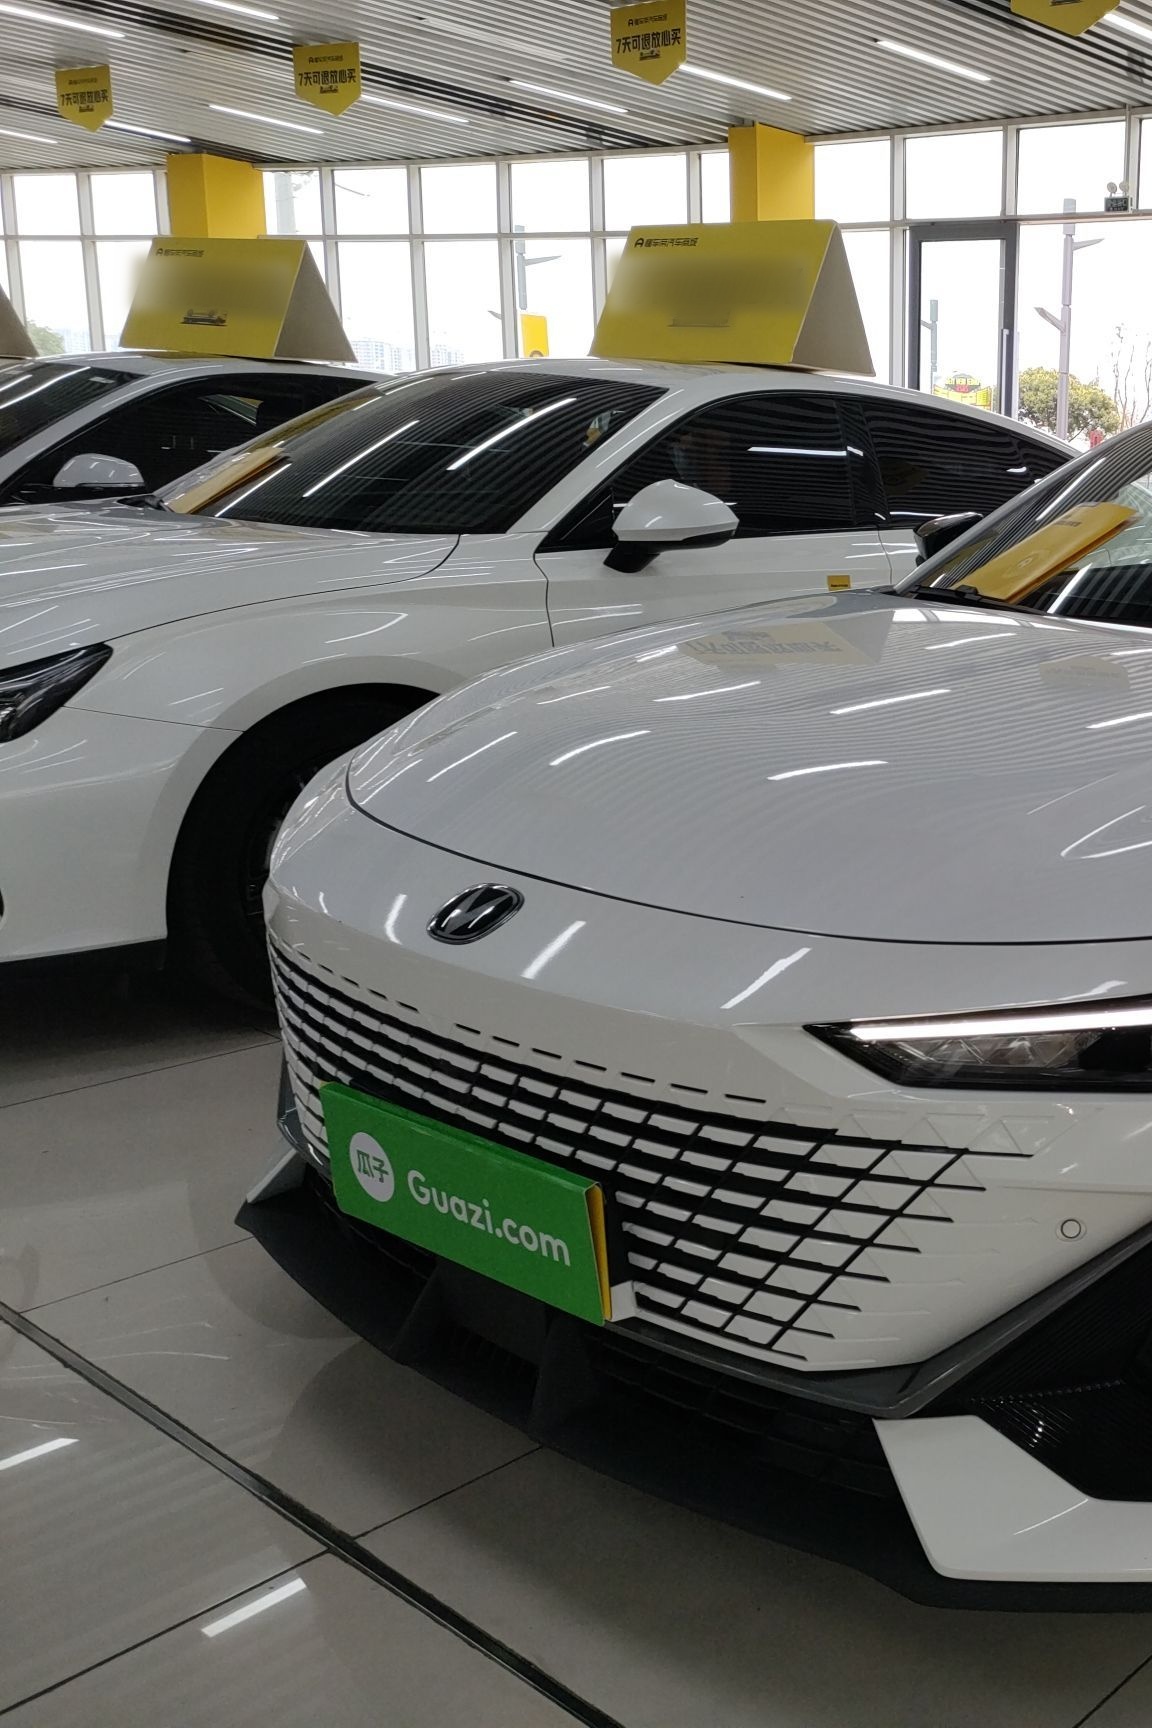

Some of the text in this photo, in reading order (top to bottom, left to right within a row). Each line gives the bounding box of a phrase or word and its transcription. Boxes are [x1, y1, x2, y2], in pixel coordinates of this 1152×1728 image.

[616, 27, 681, 54] 7天可退放心买
[298, 68, 357, 86] 7天可退放心买
[355, 1149, 571, 1267] 瓜子 Guazi.com
